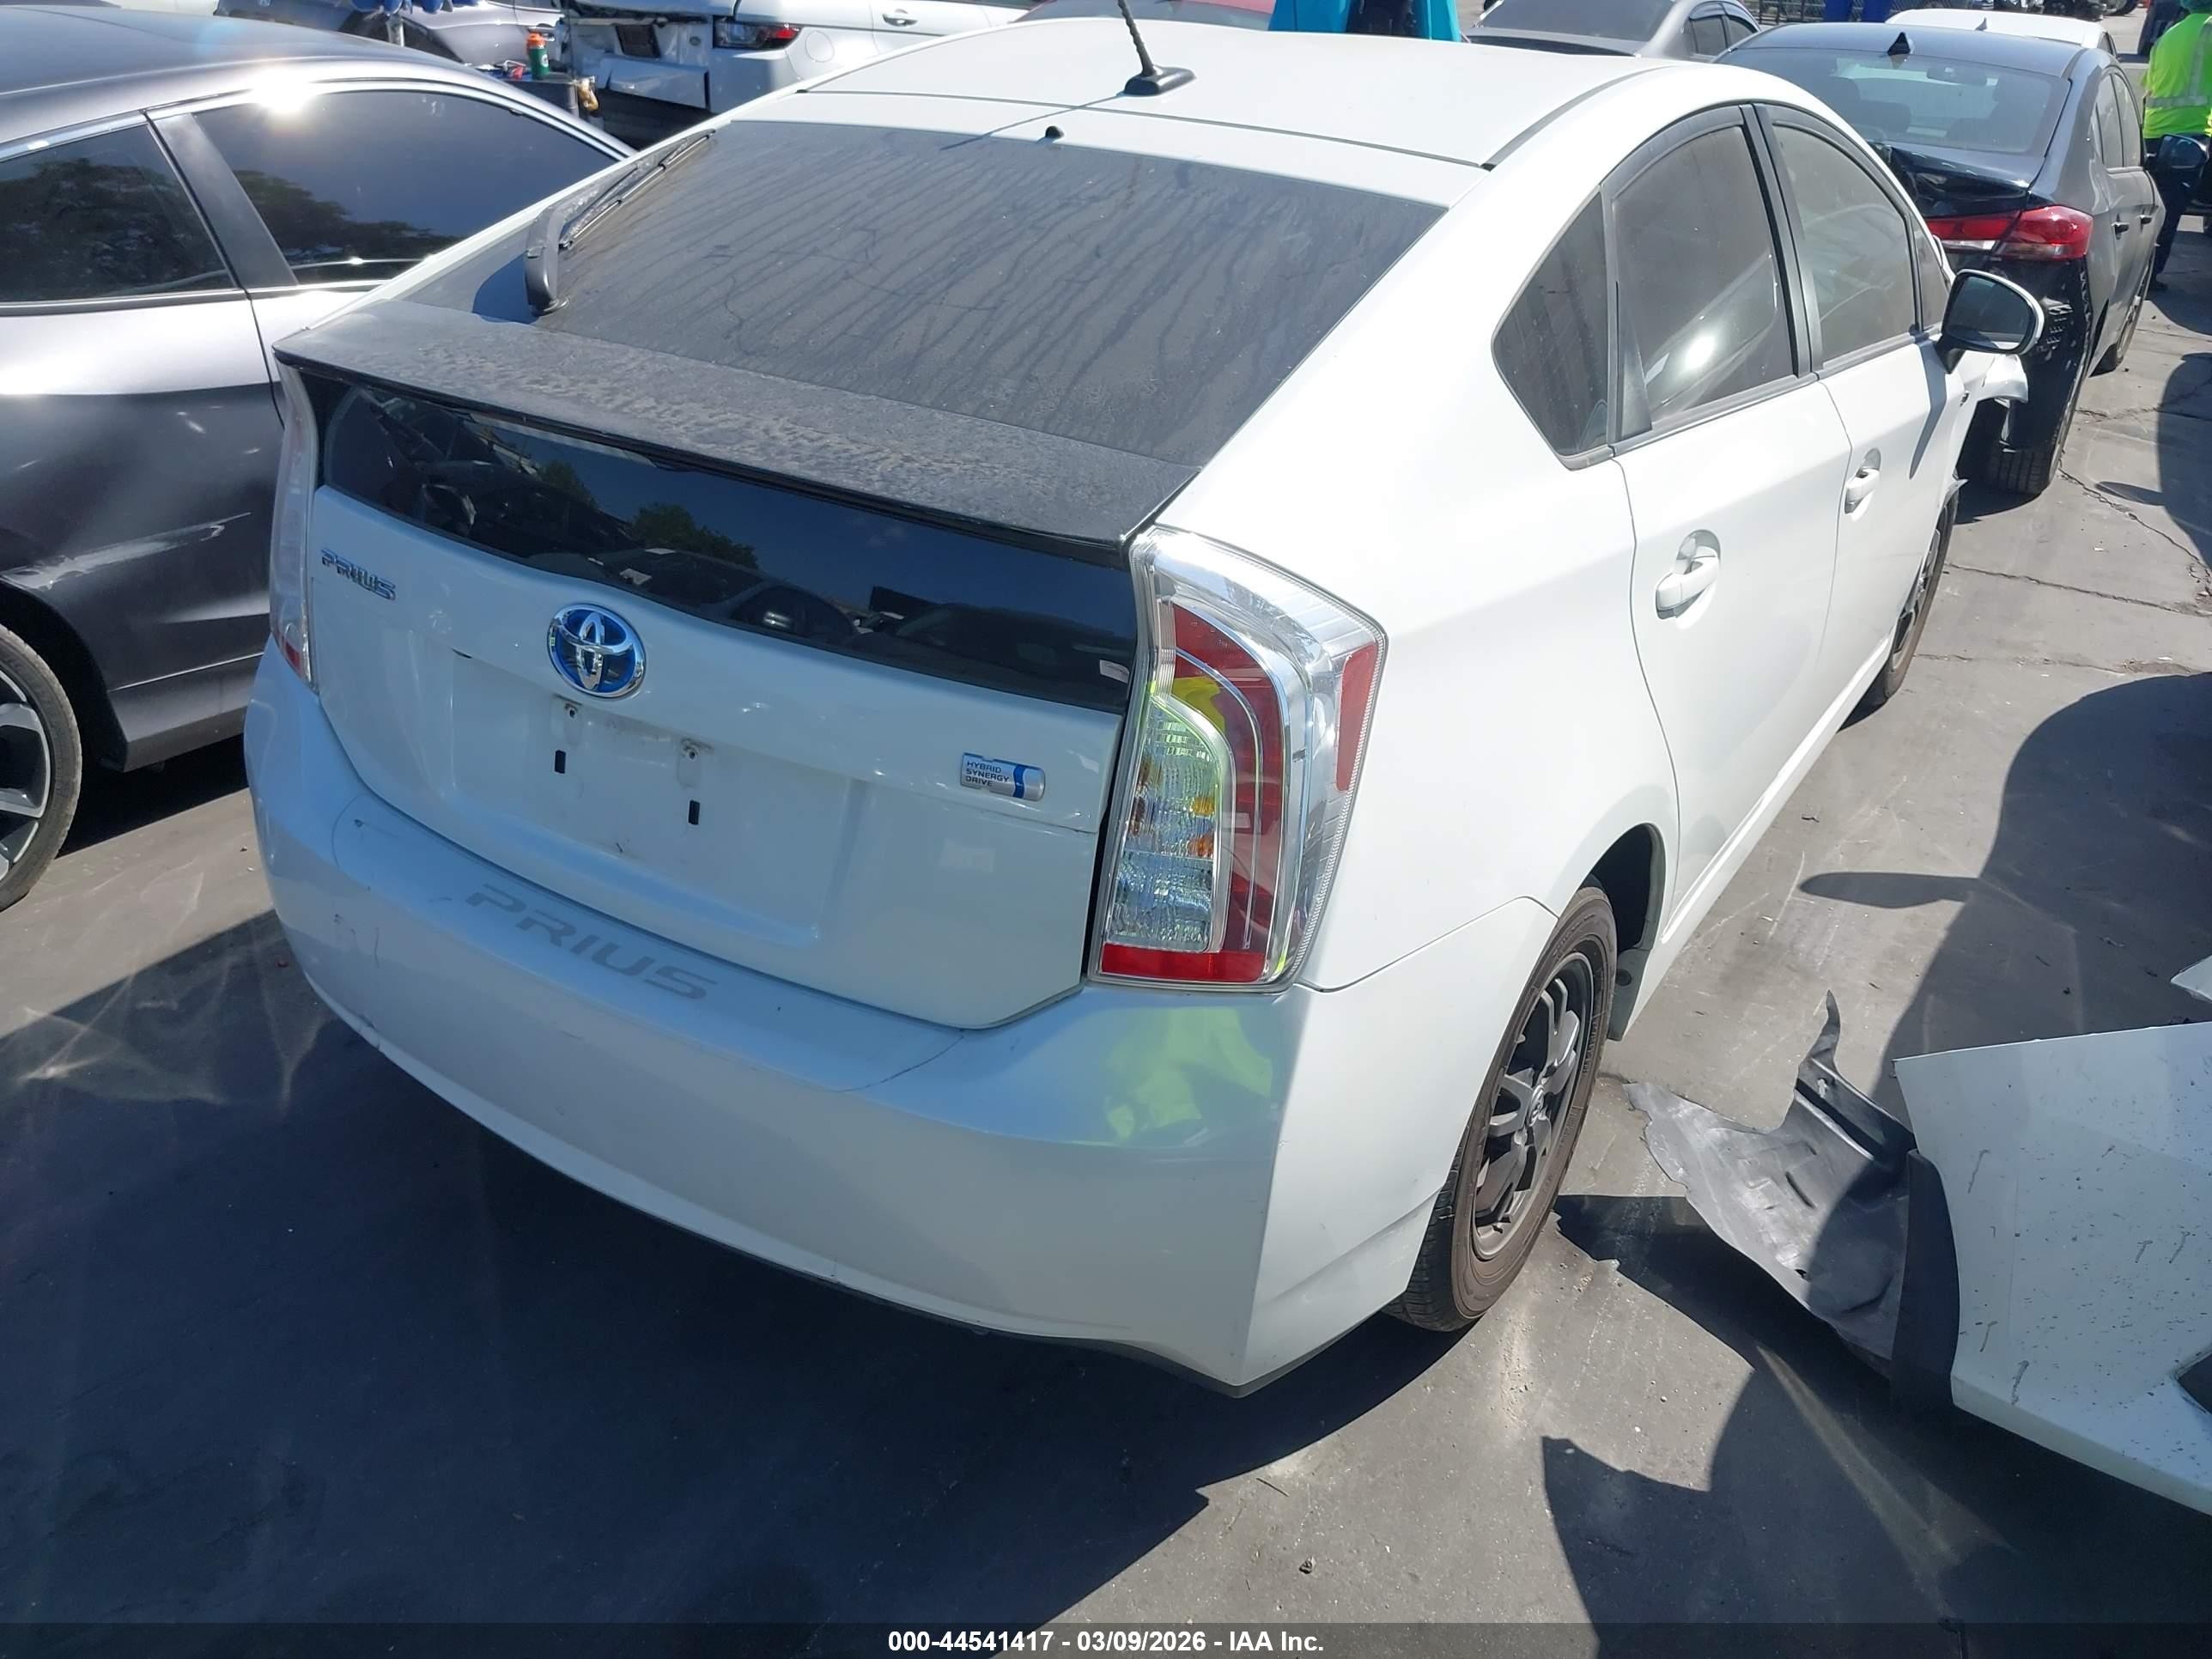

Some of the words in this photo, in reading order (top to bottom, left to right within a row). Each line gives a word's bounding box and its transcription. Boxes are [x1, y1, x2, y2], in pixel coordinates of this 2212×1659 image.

[321, 549, 396, 600] PRIUS
[967, 760, 1002, 774] HYBRID
[965, 775, 994, 787] DRIVE
[966, 768, 1010, 783] SYNERGY
[465, 883, 718, 1000] PRIUS
